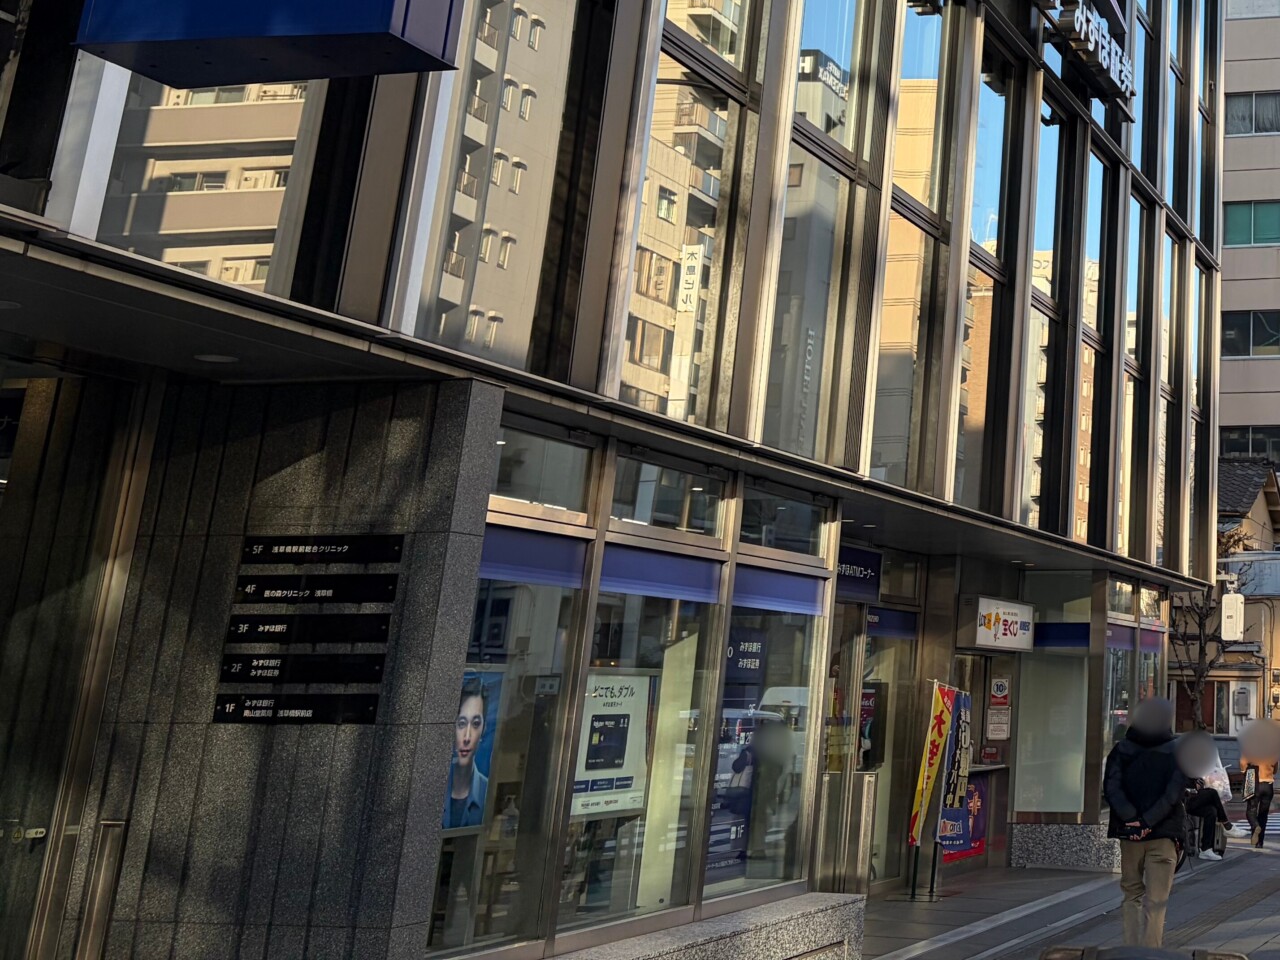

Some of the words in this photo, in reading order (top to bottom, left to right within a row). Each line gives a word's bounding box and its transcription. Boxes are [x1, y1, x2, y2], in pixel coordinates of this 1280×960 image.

[252, 545, 264, 554] 5F
[271, 545, 348, 553] 浅草橋駅前総合クリニック
[245, 584, 256, 593] 4F
[237, 624, 249, 633] 3F
[257, 624, 287, 632] みずほ銀行
[1002, 618, 1018, 638] 宝くじ
[739, 641, 762, 653] みずほ銀行
[252, 659, 281, 667] みずほ銀行
[231, 664, 242, 672] 2F
[250, 669, 280, 677] みずほ証券
[244, 699, 275, 707] みずほ銀行
[225, 704, 236, 713] 1F
